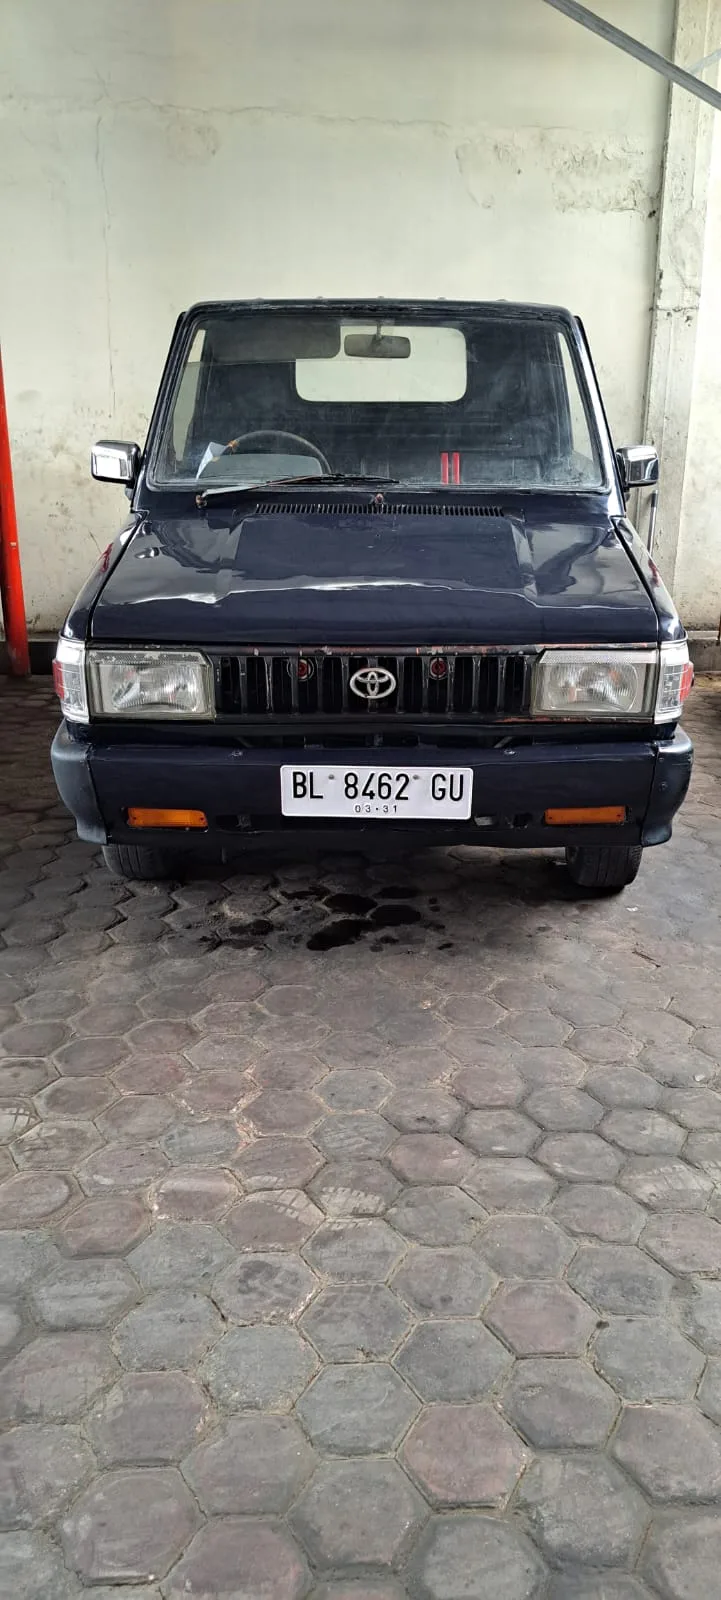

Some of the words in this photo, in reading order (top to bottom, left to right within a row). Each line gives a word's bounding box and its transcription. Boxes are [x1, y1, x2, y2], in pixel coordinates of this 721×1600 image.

[292, 771, 323, 799] BL
[344, 772, 409, 801] 8462
[431, 773, 464, 802] GU
